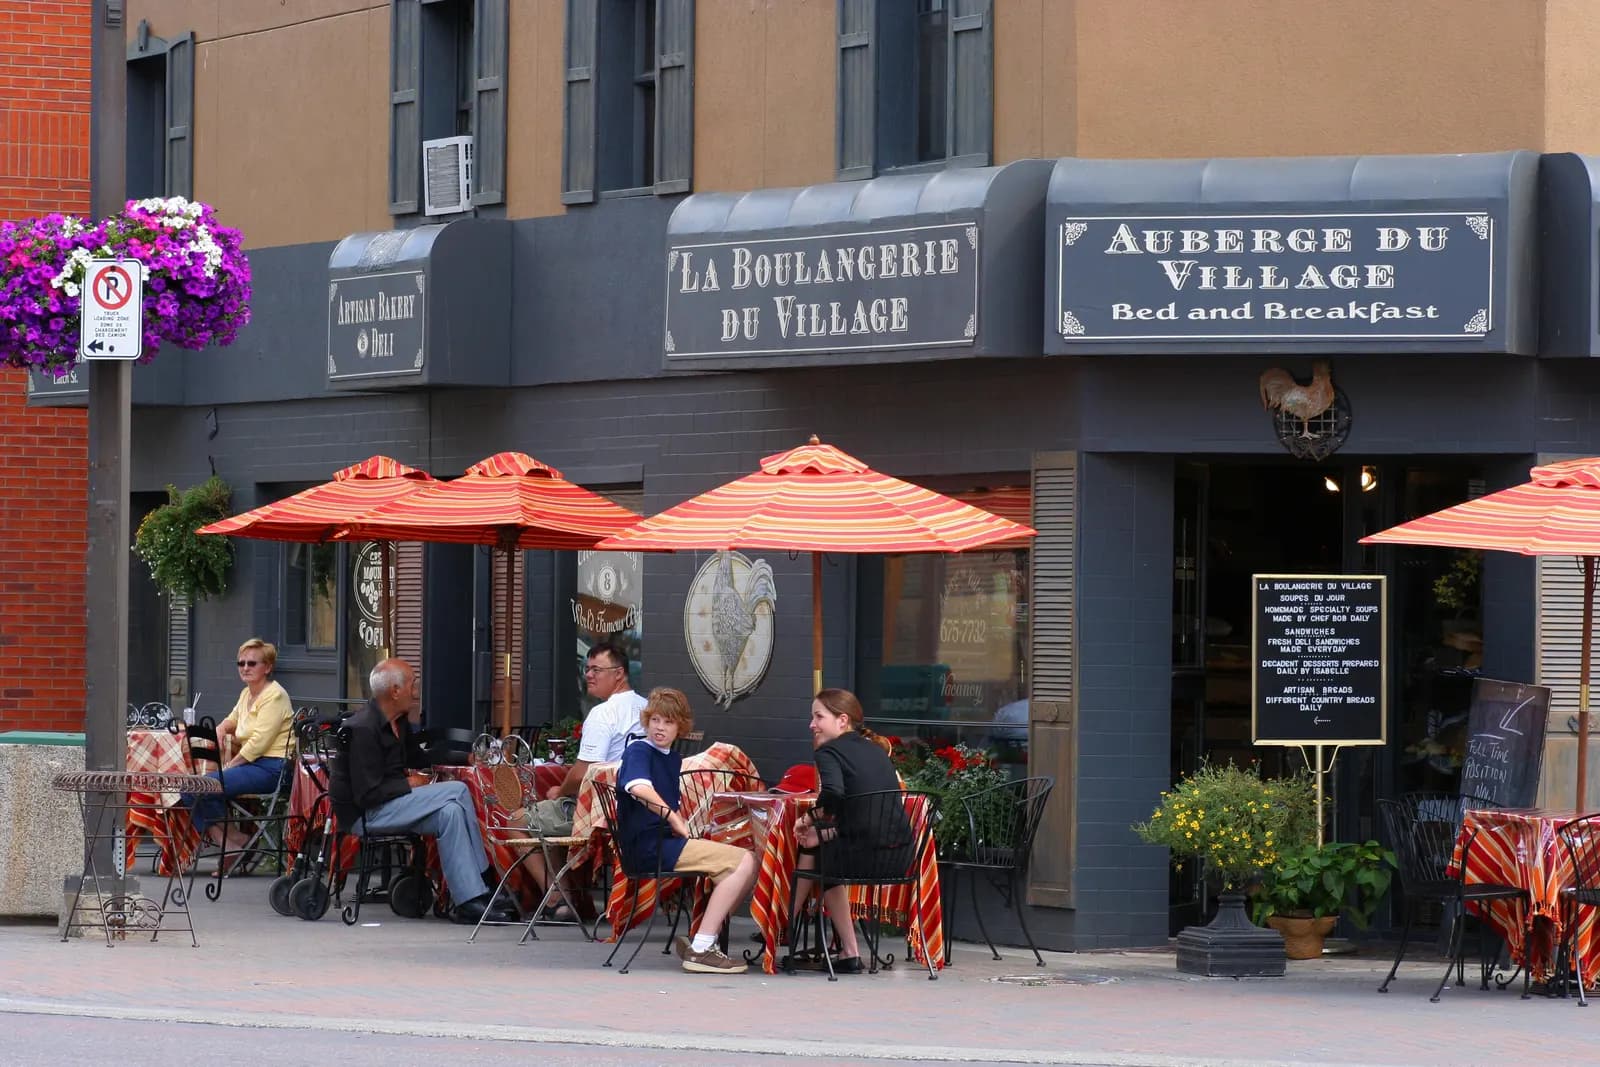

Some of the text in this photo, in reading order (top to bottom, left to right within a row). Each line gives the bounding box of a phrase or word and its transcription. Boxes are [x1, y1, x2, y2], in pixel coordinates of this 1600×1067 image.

[1104, 223, 1450, 254] AUBERGE DU
[680, 238, 959, 293] LA BOULANGERIE
[1158, 259, 1395, 291] VILLAGE
[338, 291, 415, 325] ARTISAN BAKERY
[720, 295, 908, 342] DU VILLAGE
[1111, 301, 1440, 324] Bed and Breakfast
[371, 328, 394, 357] DELI
[1280, 594, 1309, 602] SOUPES
[1341, 582, 1372, 590] VILLAGE
[1267, 638, 1292, 646] FRESH
[939, 672, 984, 705] Vacancy
[1463, 757, 1508, 783] POSITION
